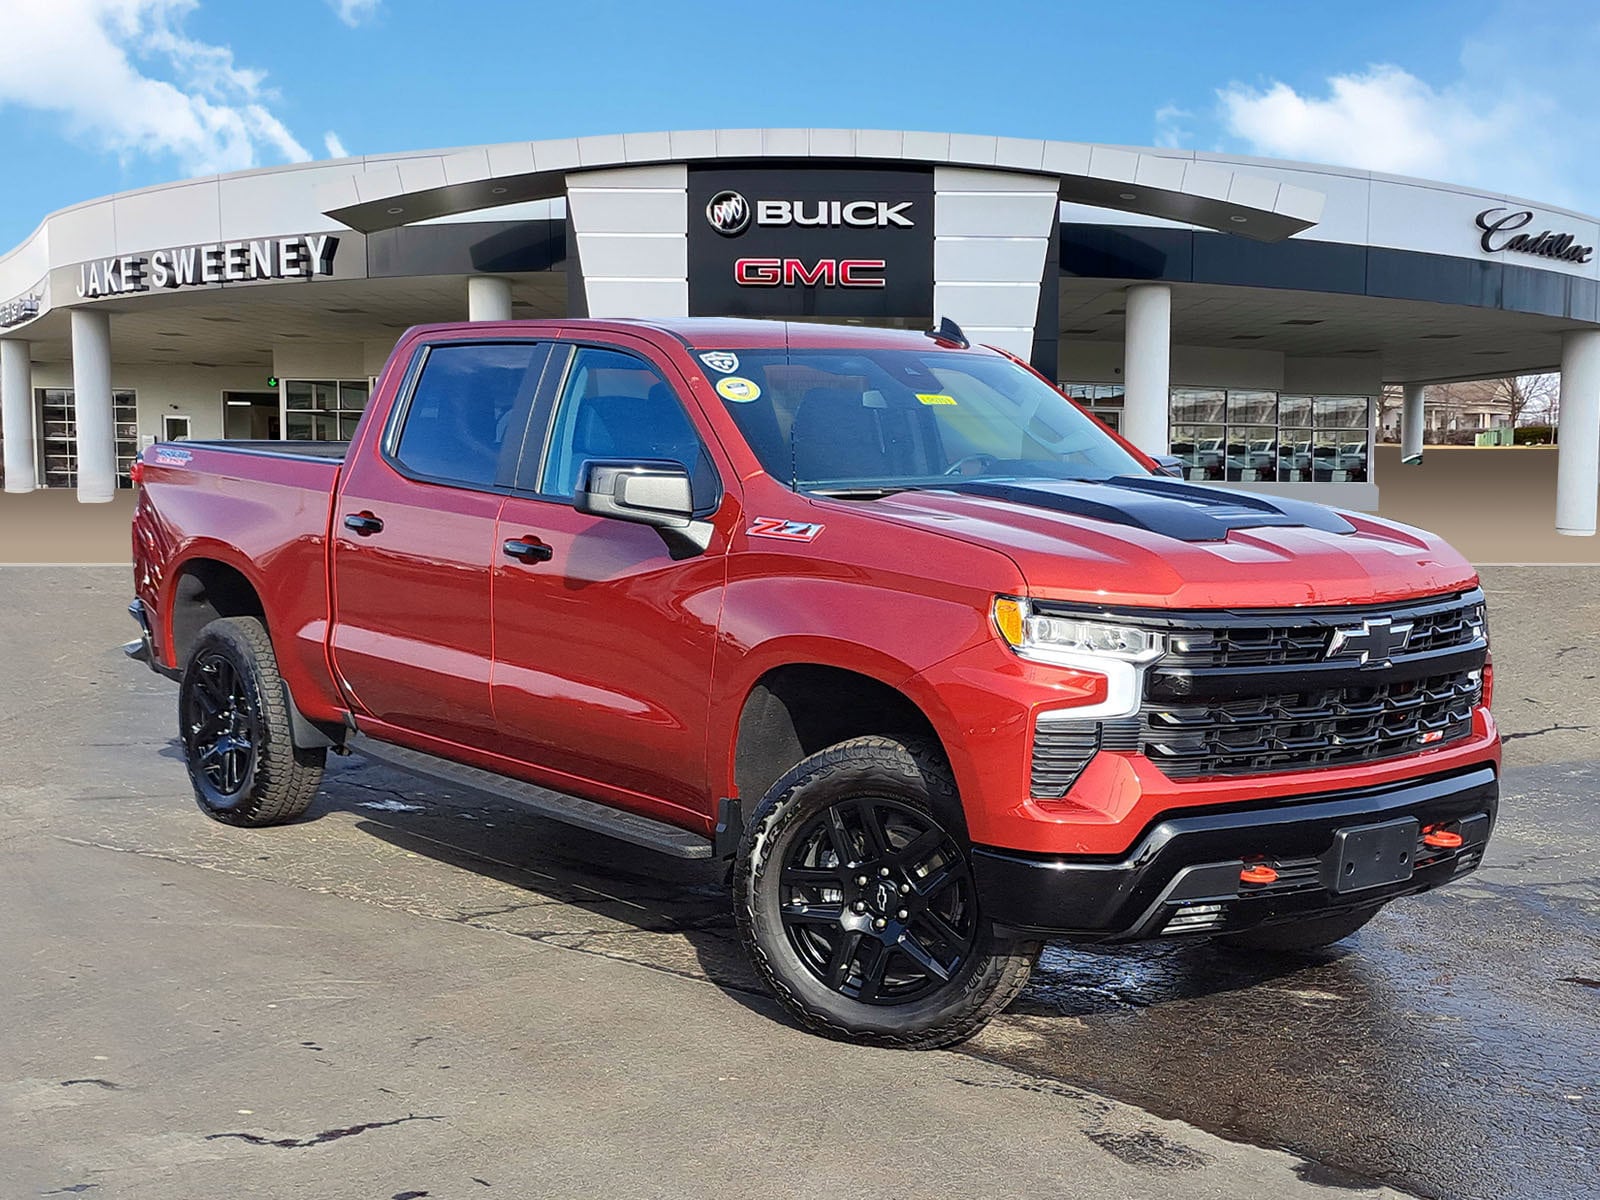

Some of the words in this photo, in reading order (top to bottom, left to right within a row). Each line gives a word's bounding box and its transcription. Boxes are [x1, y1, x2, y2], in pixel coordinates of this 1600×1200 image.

[757, 200, 915, 226] BUICK
[1475, 207, 1593, 264] Cadillac
[76, 255, 138, 299] JAKE
[152, 234, 331, 288] SWEENEY
[735, 258, 886, 287] GMC
[745, 516, 826, 542] Z71
